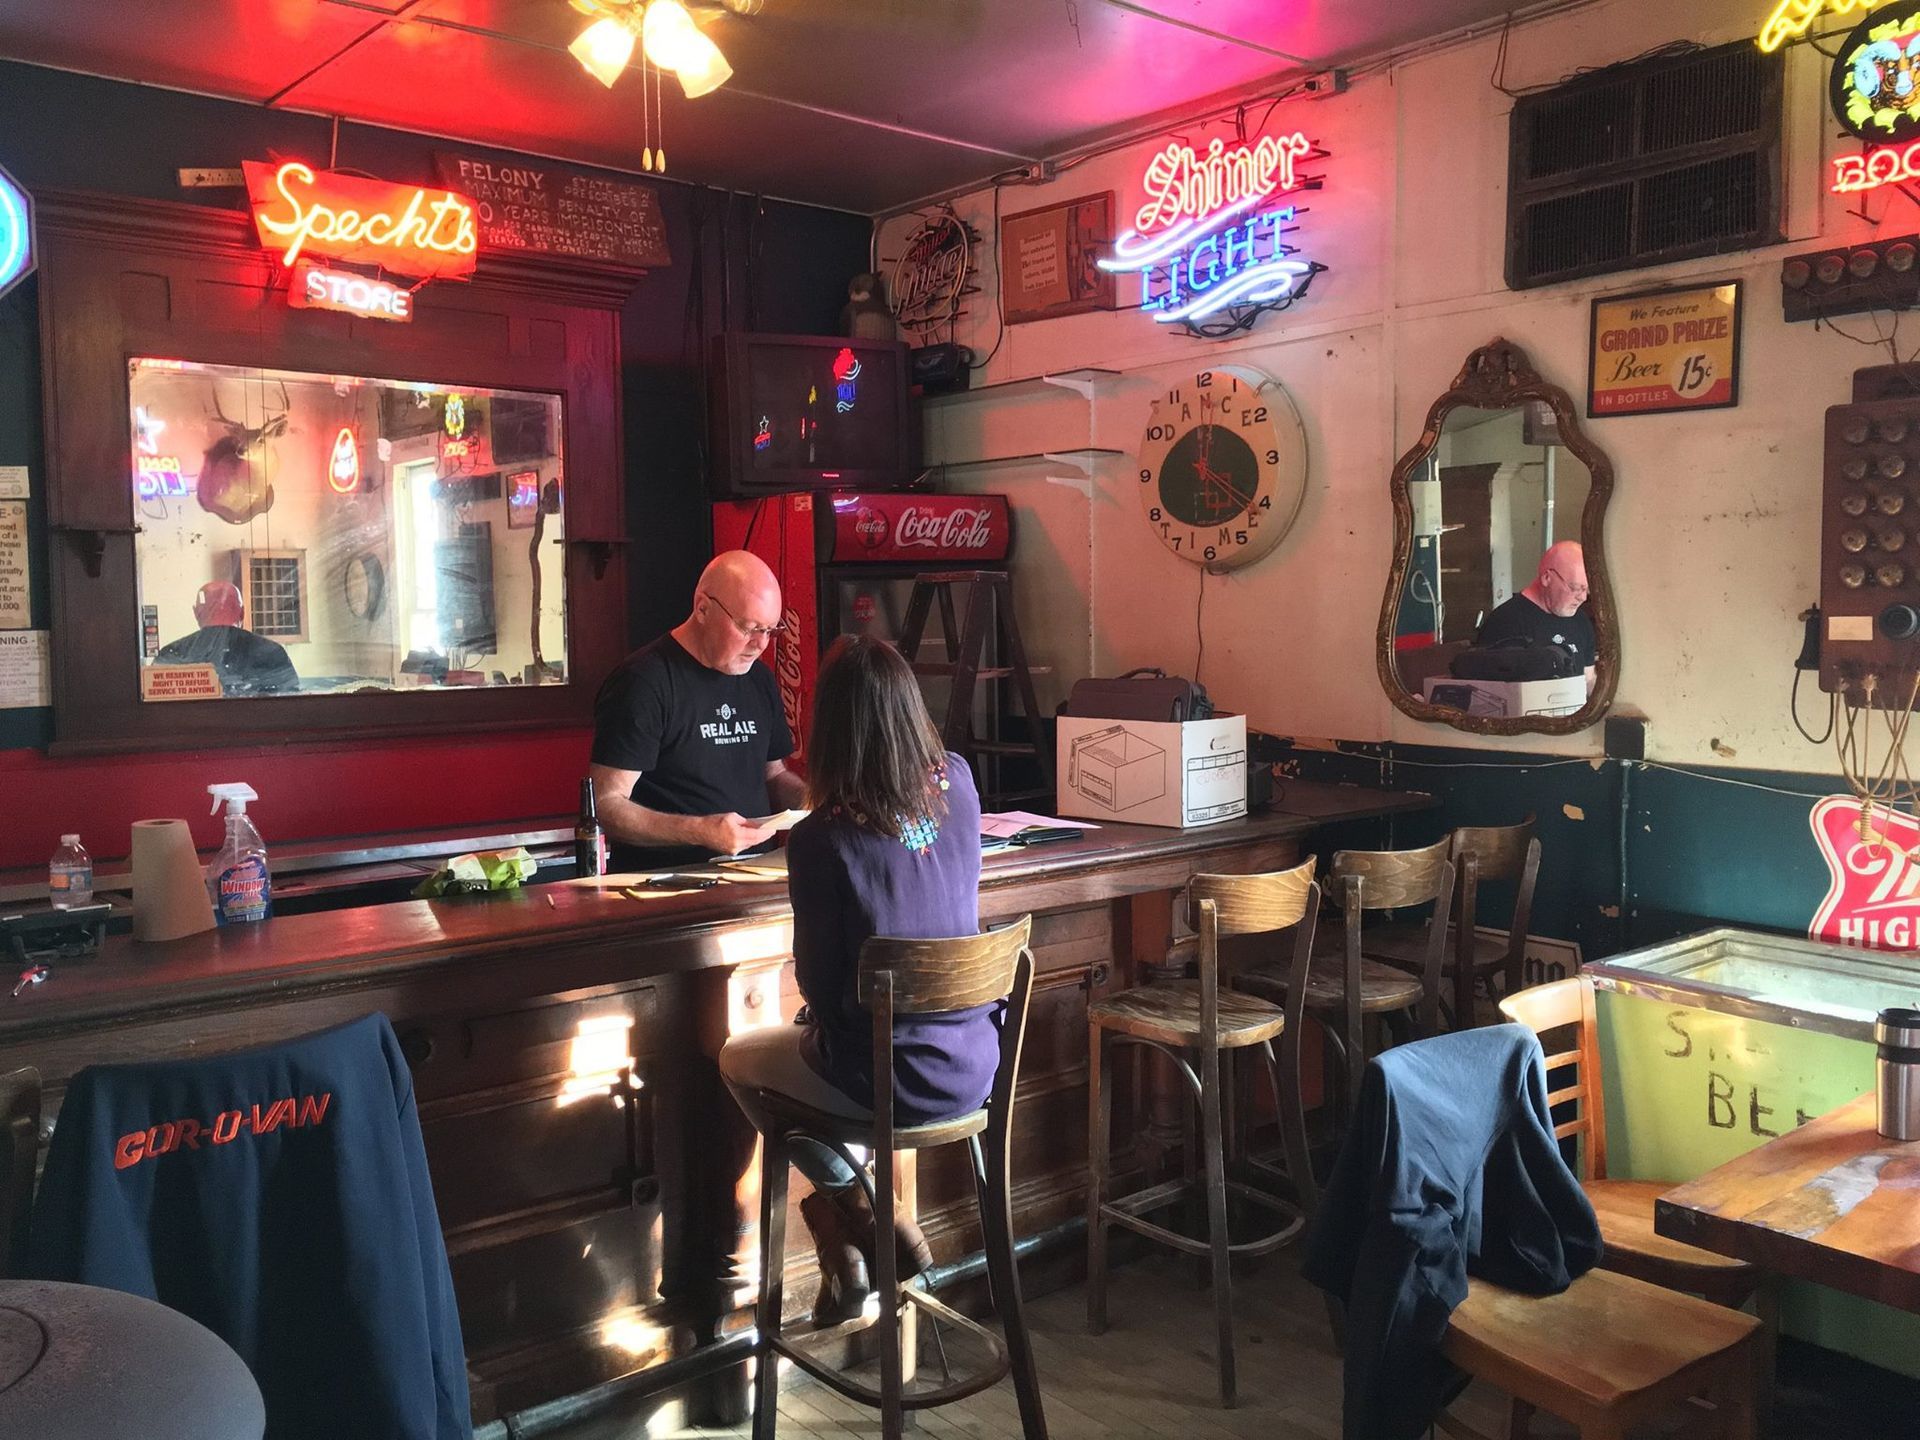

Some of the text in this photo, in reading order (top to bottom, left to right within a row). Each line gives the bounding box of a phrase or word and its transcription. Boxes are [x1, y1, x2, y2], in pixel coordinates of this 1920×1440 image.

[458, 160, 544, 189] FELONY
[1136, 132, 1310, 231] Shiner
[464, 180, 548, 207] MAXIMUM
[259, 162, 476, 267] Specht's
[558, 199, 648, 224] PENALTY OF
[502, 205, 550, 224] YEARS
[556, 213, 660, 240] IMPRISONMENT
[1141, 206, 1296, 310] LIGHT
[306, 271, 411, 317] STORE
[1630, 304, 1700, 321] We Feature
[1600, 316, 1728, 352] GRAND PRIZE
[1606, 352, 1663, 383] Beer
[1197, 372, 1213, 388] 12
[1232, 379, 1237, 392] 1
[1169, 389, 1180, 404] 11
[1600, 390, 1669, 406] IN BOTTLES
[1253, 407, 1268, 423] 2
[1146, 425, 1162, 441] 10
[1265, 450, 1279, 465] 3
[1139, 469, 1152, 483] 9
[1258, 495, 1271, 510] 4
[1150, 508, 1161, 521] 8
[894, 507, 992, 548] Coca-Cola
[1171, 537, 1182, 551] 7
[1235, 530, 1248, 546] 5
[1203, 546, 1217, 560] 6
[0, 636, 28, 645] NING
[165, 671, 195, 679] RESERVE
[196, 670, 209, 678] THE
[188, 686, 216, 694] ANYONE
[700, 720, 758, 739] REAL ALE
[221, 878, 265, 895] WINDOW
[1839, 916, 1920, 949] HIG
